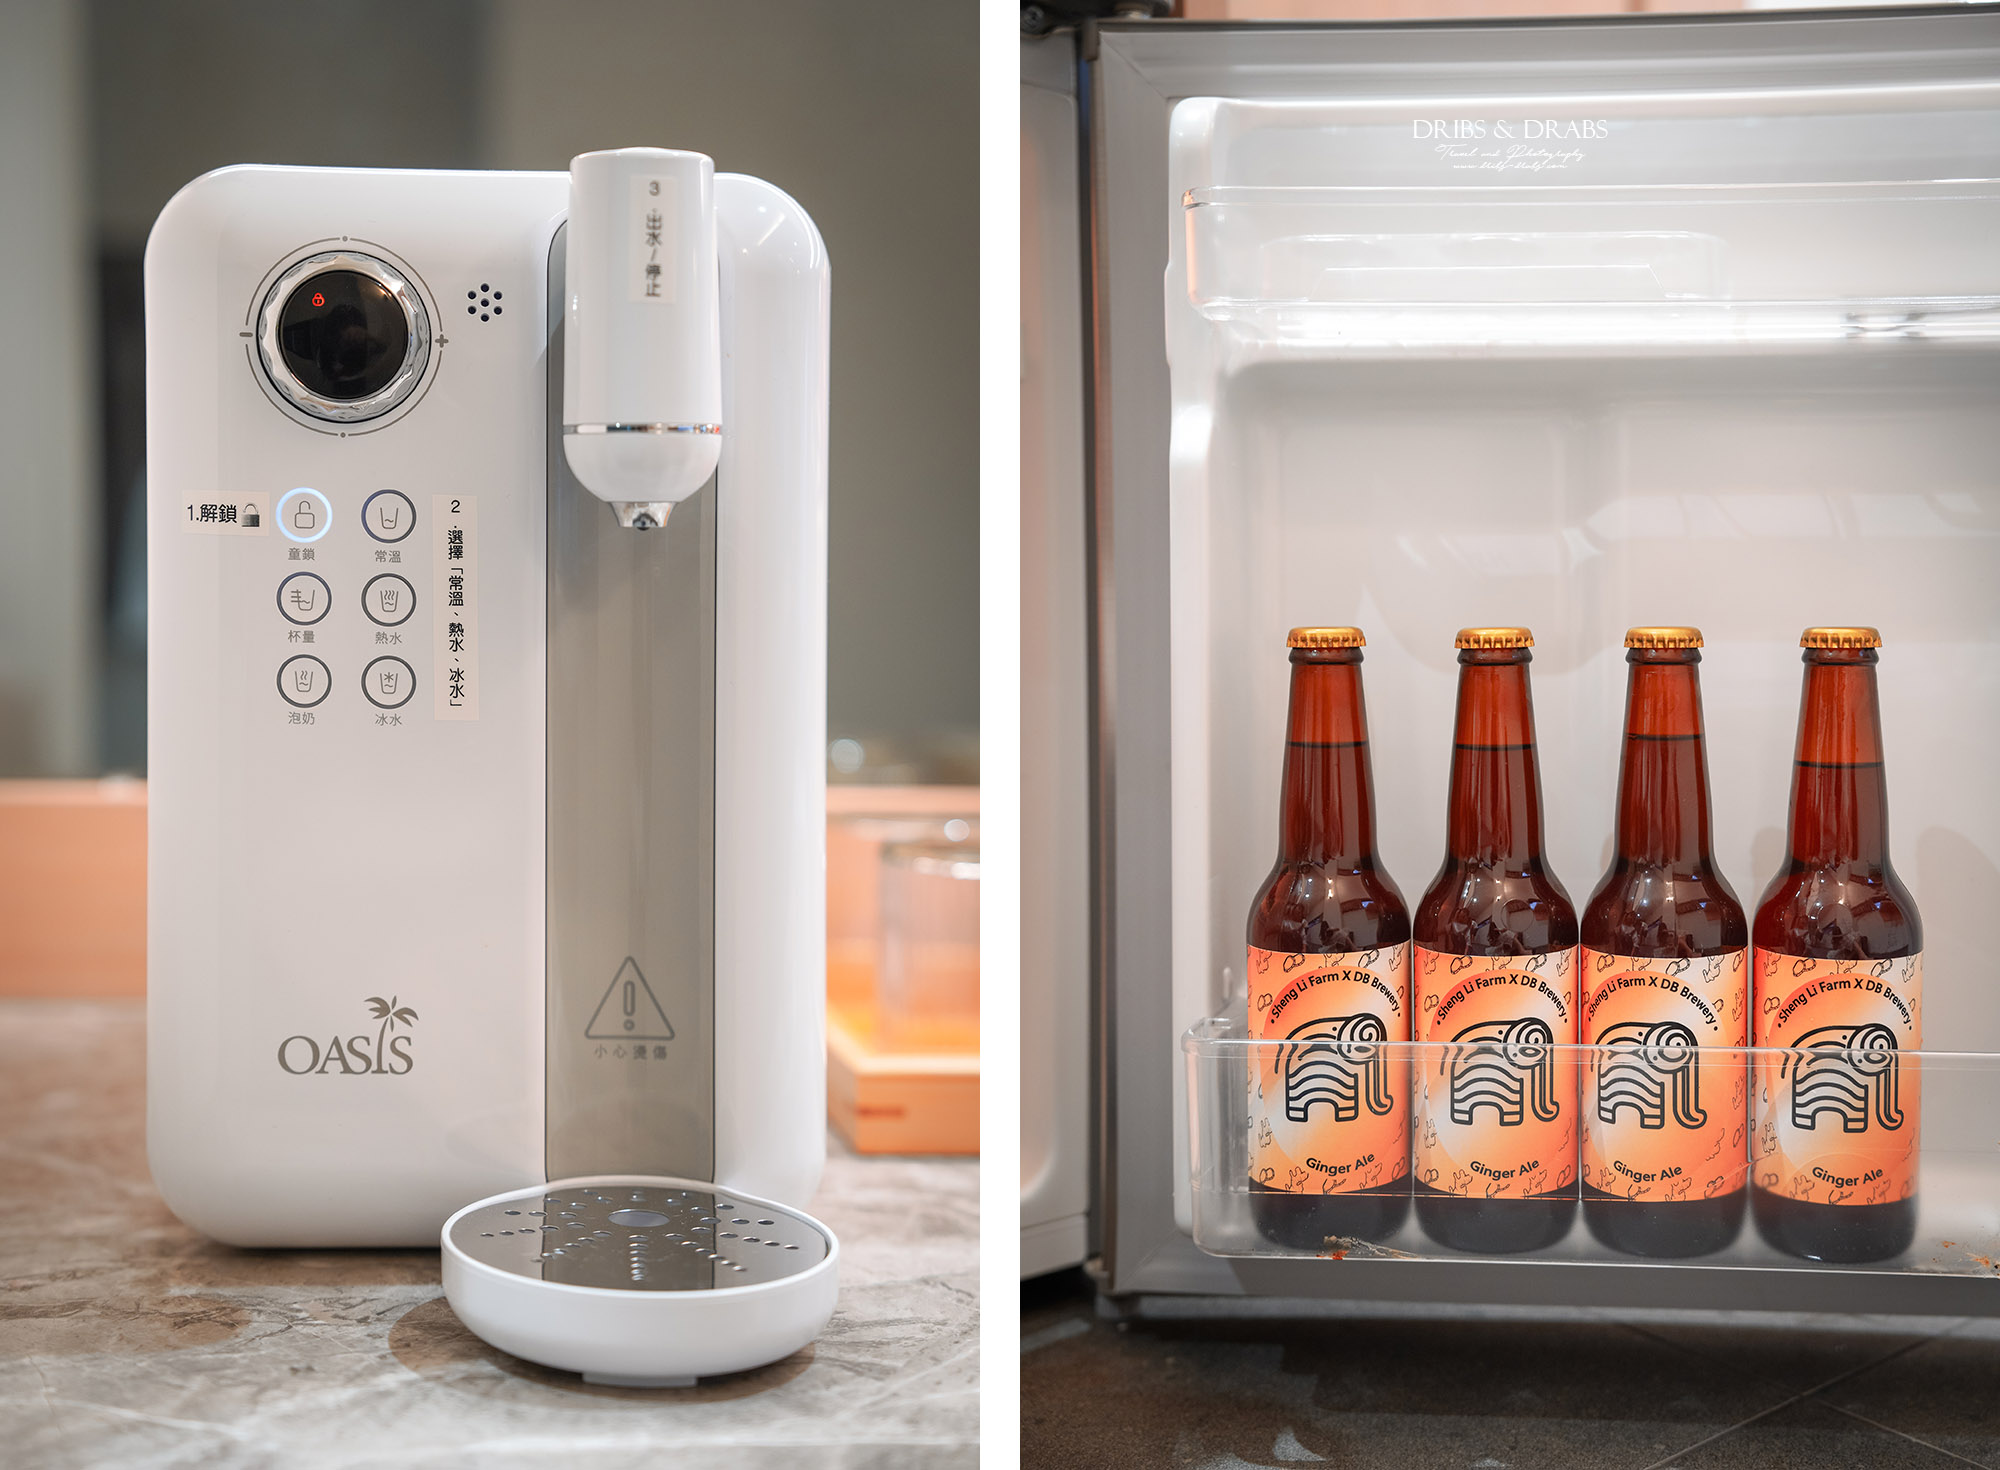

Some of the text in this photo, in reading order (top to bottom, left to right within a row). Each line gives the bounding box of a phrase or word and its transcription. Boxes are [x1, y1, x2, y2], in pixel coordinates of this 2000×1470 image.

[187, 503, 237, 524] 1.解鎖
[288, 547, 315, 561] 童鎖
[288, 629, 315, 644] 杯量
[375, 631, 402, 645] 熱水
[288, 711, 315, 726] 泡奶
[375, 712, 402, 726] 冰水
[1271, 970, 1400, 1018] Sheng Li Farm X DB Brewery
[1437, 973, 1567, 1020] Sheng Li Farm X DB Brewery
[1588, 975, 1717, 1025] Sheng Li Farm X DB Brewery
[1779, 978, 1911, 1025] Sheng Li Farm X DB Brewery
[277, 1015, 414, 1076] OASIS
[1305, 1152, 1376, 1175] Ginger Ale
[1470, 1158, 1540, 1180] Ginger Ale
[1613, 1160, 1683, 1183] Ginger Ale
[1811, 1166, 1884, 1187] Ginger Ale
